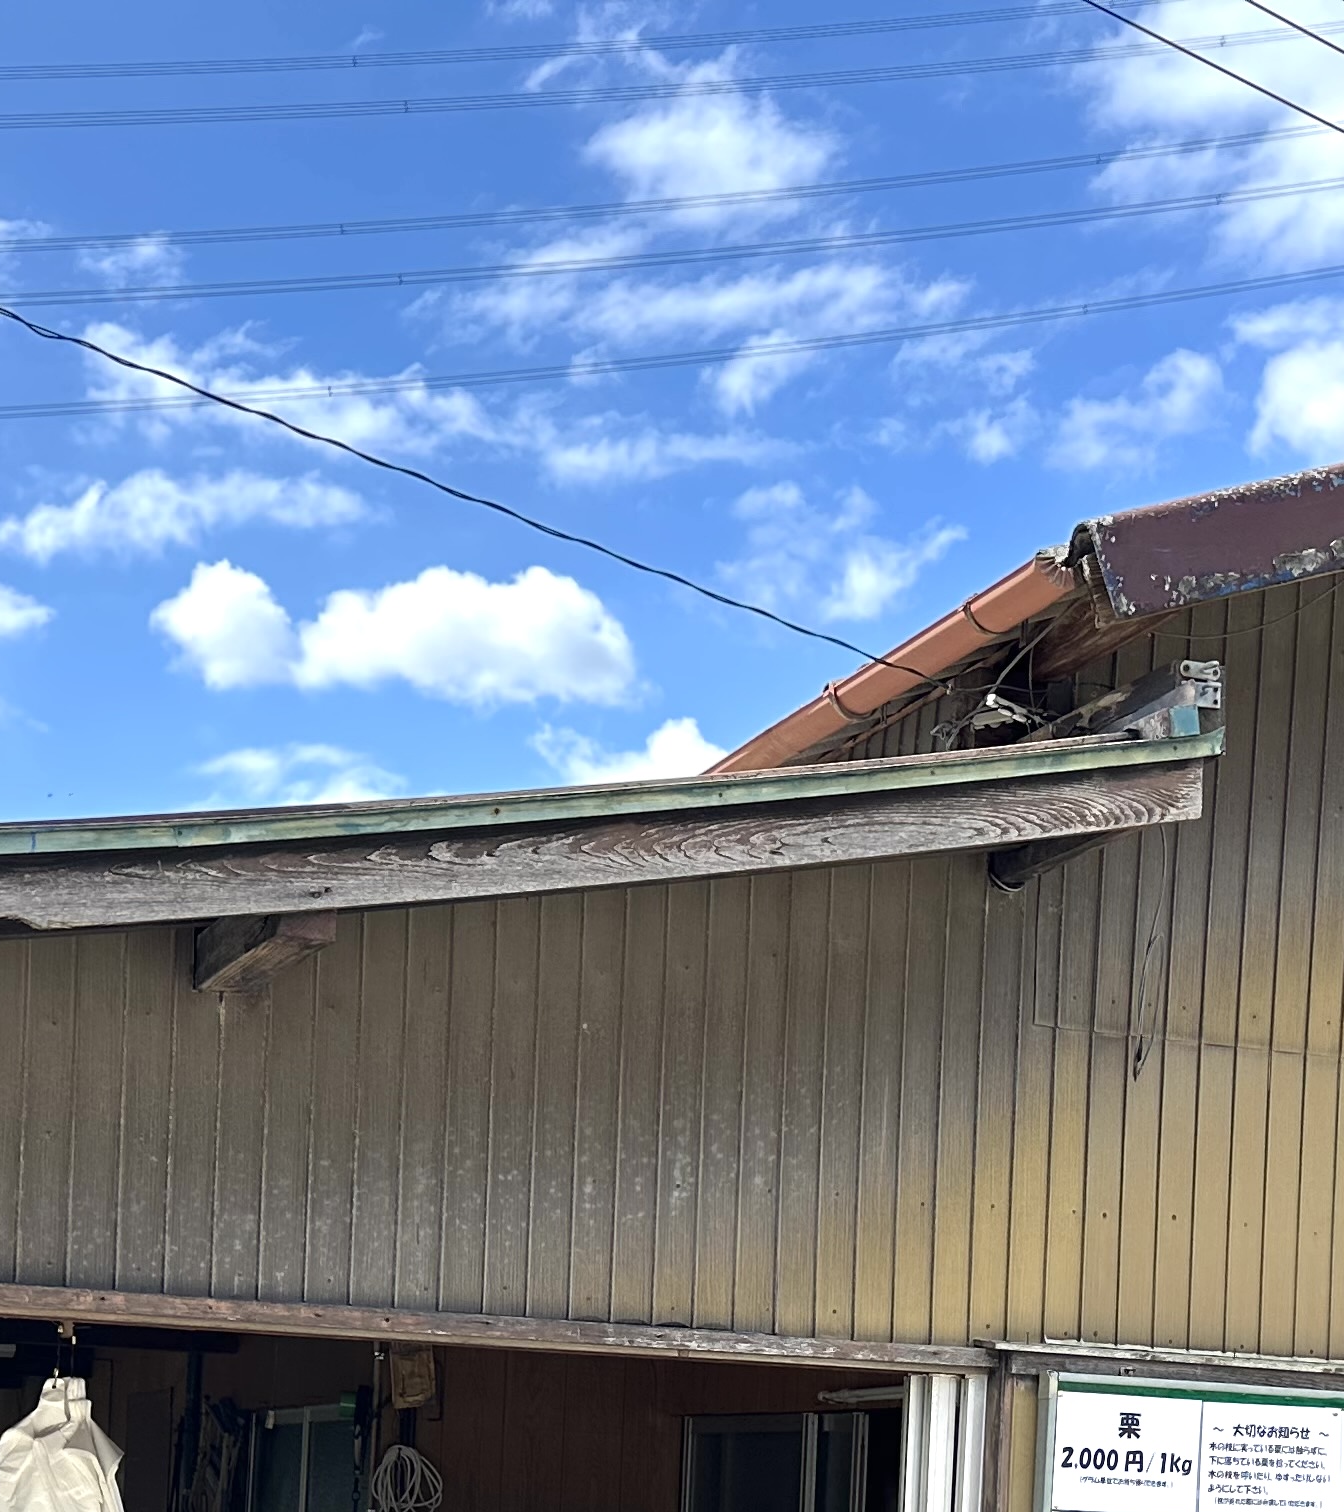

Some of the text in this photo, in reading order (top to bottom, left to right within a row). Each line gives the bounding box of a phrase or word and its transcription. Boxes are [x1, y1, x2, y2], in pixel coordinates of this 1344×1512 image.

[1118, 1412, 1141, 1439] 栗
[1233, 1424, 1310, 1440] 大切なお知らせ
